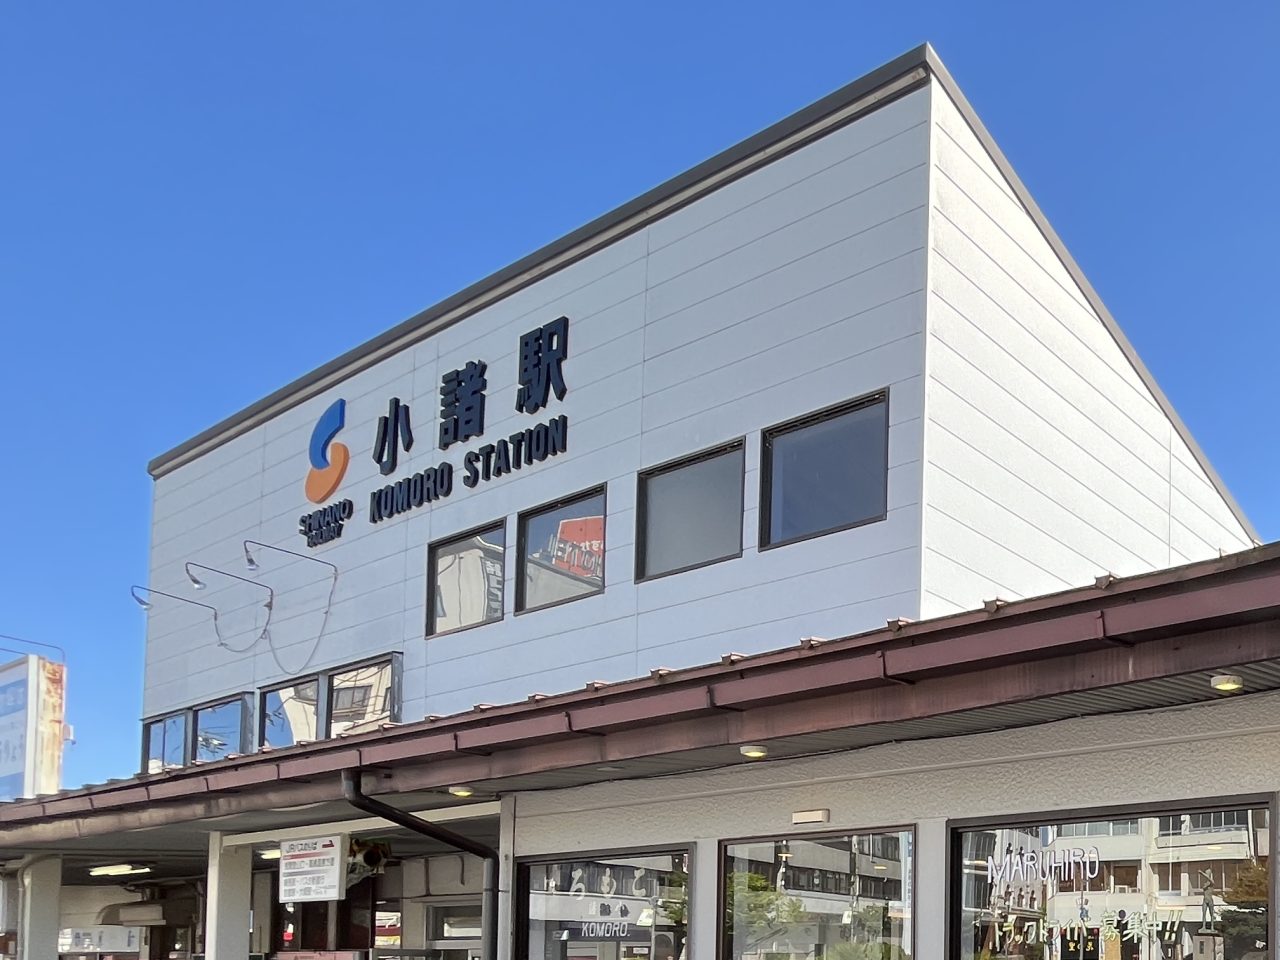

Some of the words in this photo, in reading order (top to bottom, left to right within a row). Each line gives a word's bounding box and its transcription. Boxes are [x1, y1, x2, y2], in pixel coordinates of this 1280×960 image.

[373, 316, 569, 476] 小諸駅
[370, 462, 453, 523] KOMORO
[463, 415, 568, 488] STATION
[299, 499, 354, 533] SHINANO
[987, 846, 1100, 884] MARUHIRO
